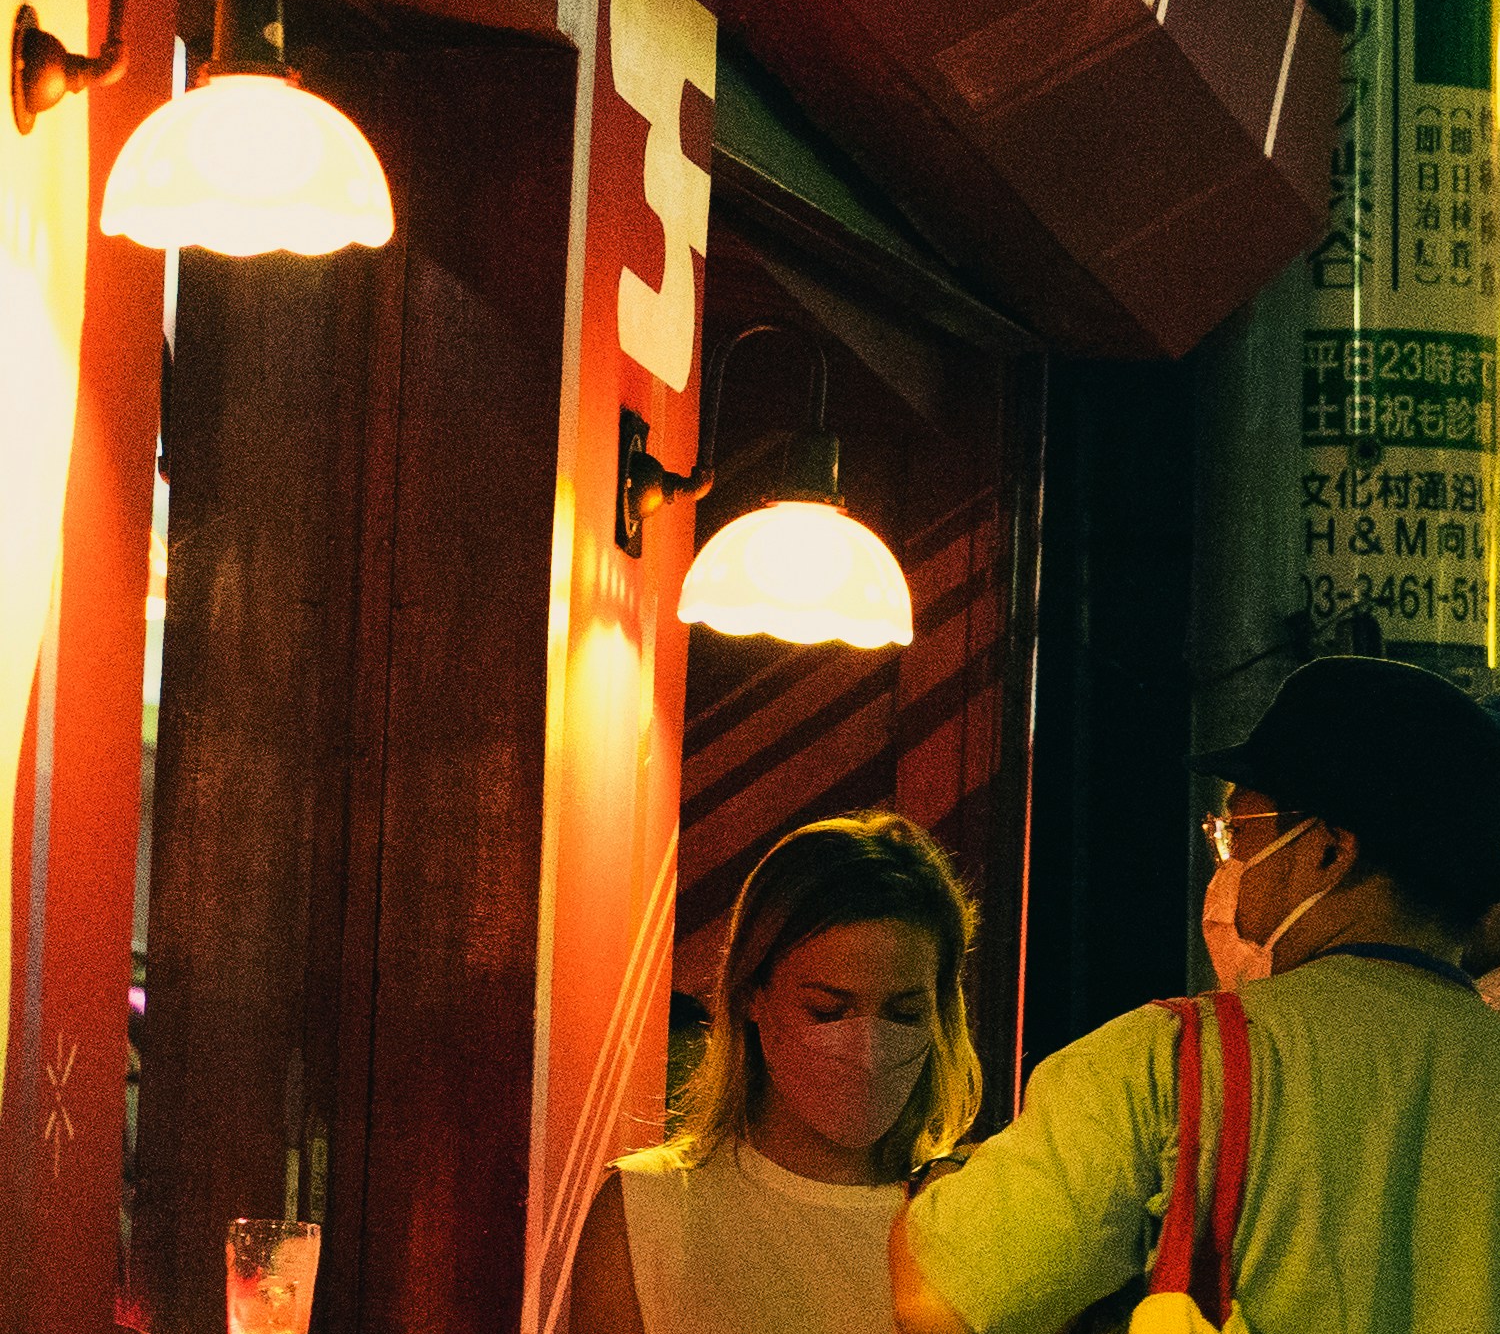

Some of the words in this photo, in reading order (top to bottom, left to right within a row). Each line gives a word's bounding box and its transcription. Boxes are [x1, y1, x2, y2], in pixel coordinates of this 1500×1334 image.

[1305, 517, 1335, 556] H
[1350, 518, 1383, 555] &
[1396, 519, 1427, 558] M
